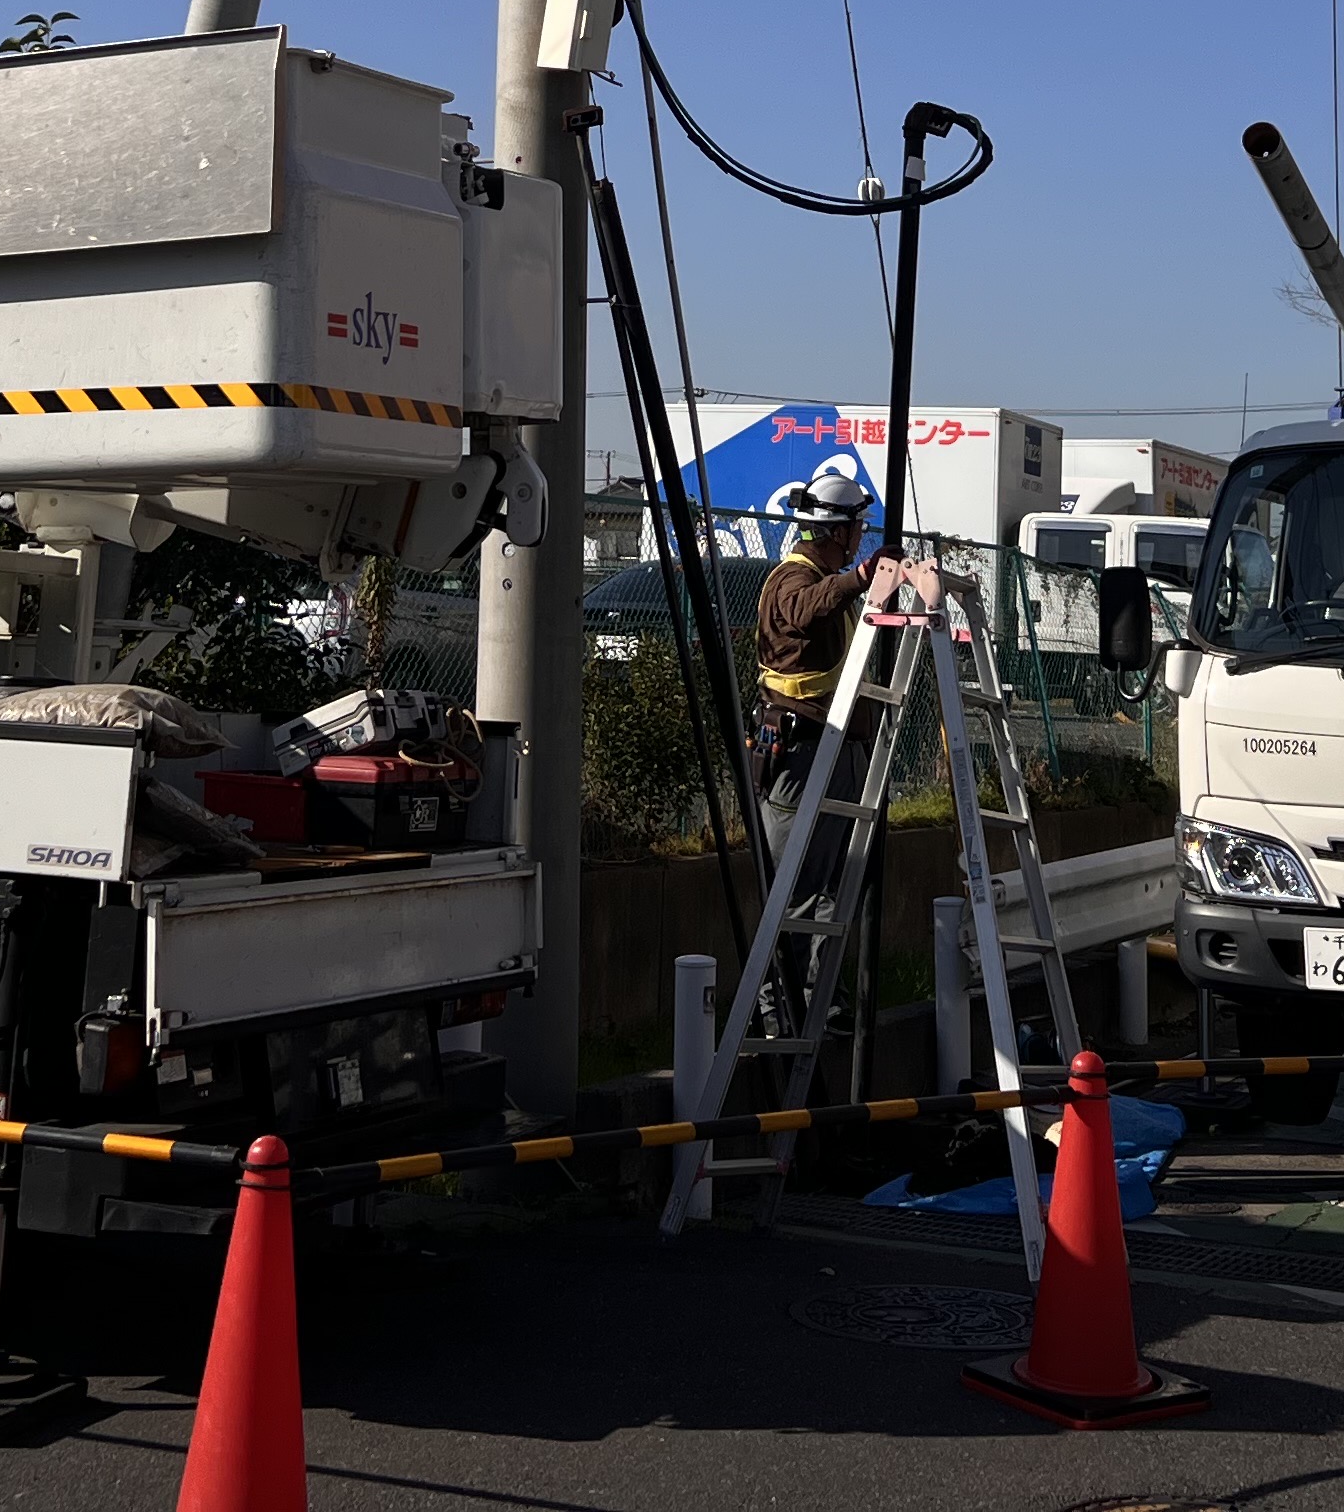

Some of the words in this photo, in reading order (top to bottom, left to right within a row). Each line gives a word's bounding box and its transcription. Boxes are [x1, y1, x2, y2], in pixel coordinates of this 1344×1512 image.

[352, 291, 398, 366] sky
[770, 416, 991, 446] アート引越ンター
[1242, 737, 1317, 756] 100205264
[1312, 961, 1328, 977] わ
